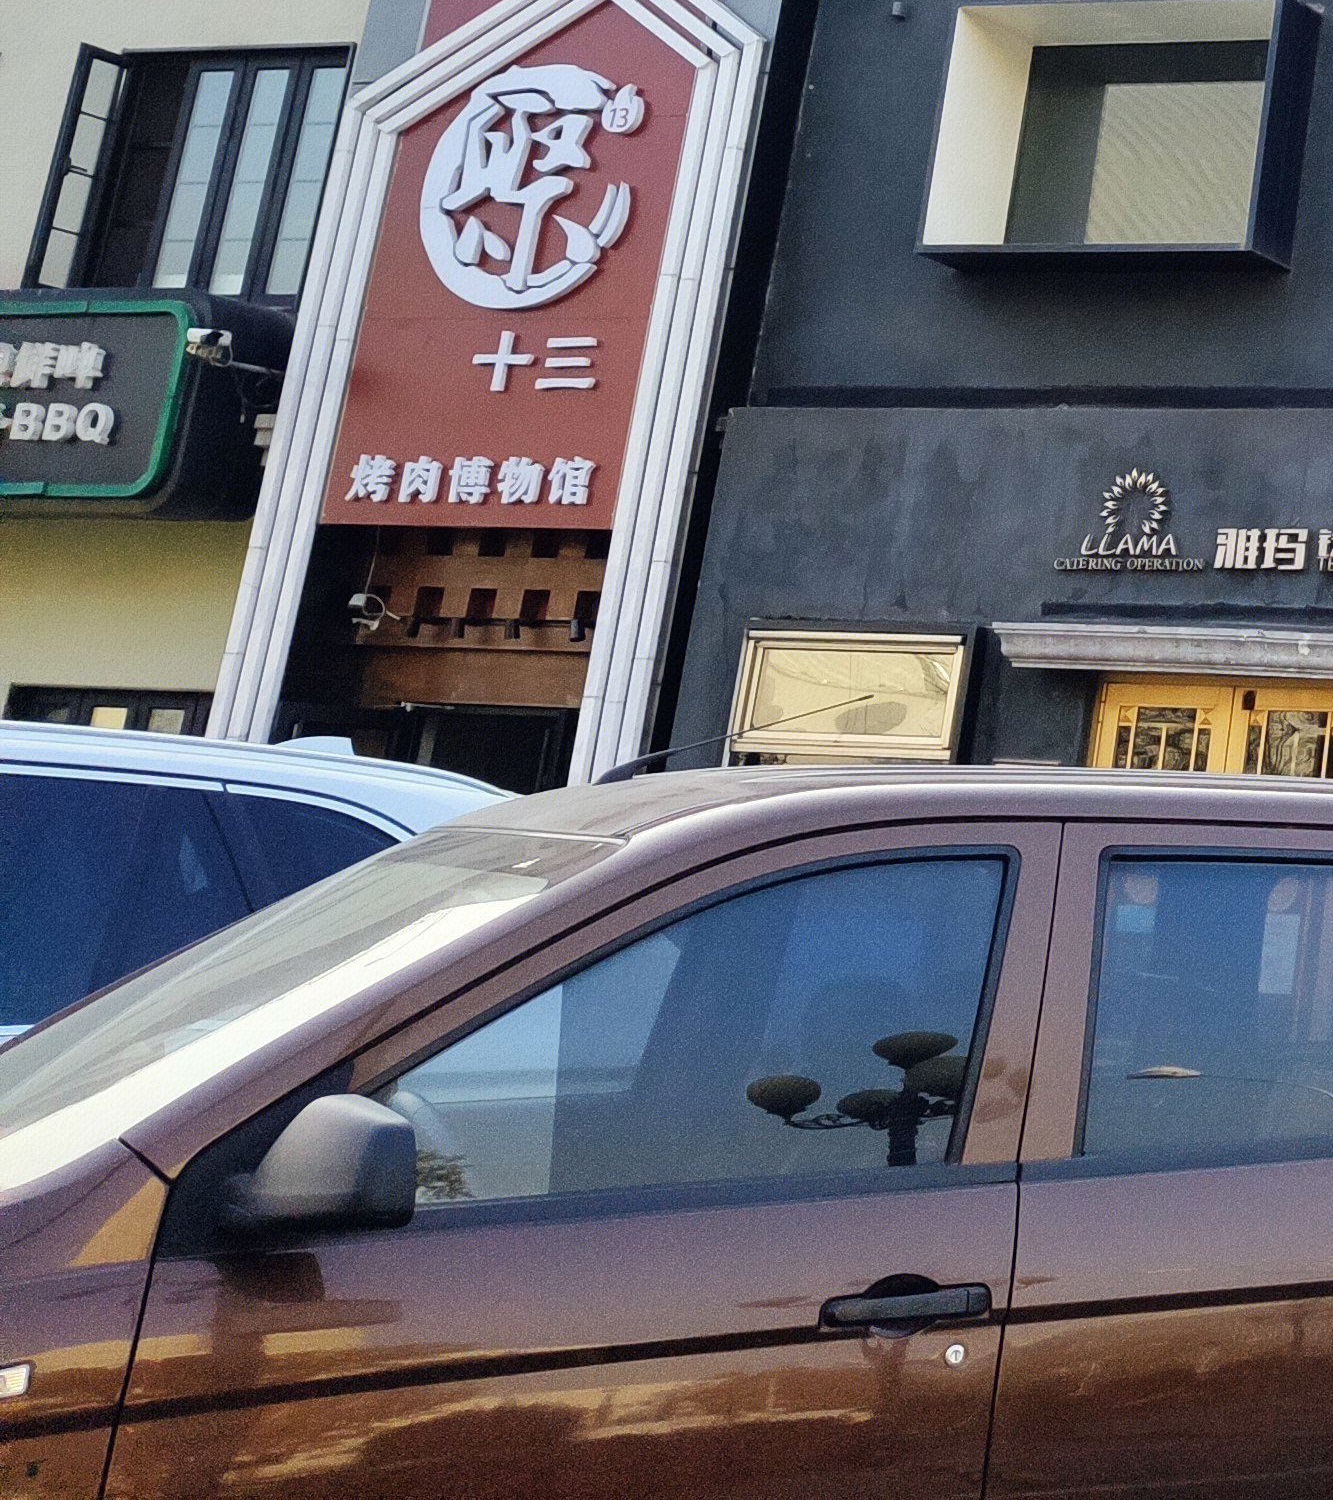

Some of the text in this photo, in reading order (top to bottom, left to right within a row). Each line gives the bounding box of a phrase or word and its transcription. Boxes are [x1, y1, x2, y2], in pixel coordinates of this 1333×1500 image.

[608, 106, 630, 131] 13
[473, 331, 599, 392] 十三
[9, 402, 115, 445] BBQ
[344, 453, 597, 505] 烤肉博物馆
[1053, 556, 1205, 572] CATERING OPERATION
[1080, 532, 1178, 556] LLAMA
[1213, 527, 1309, 570] 雅玛
